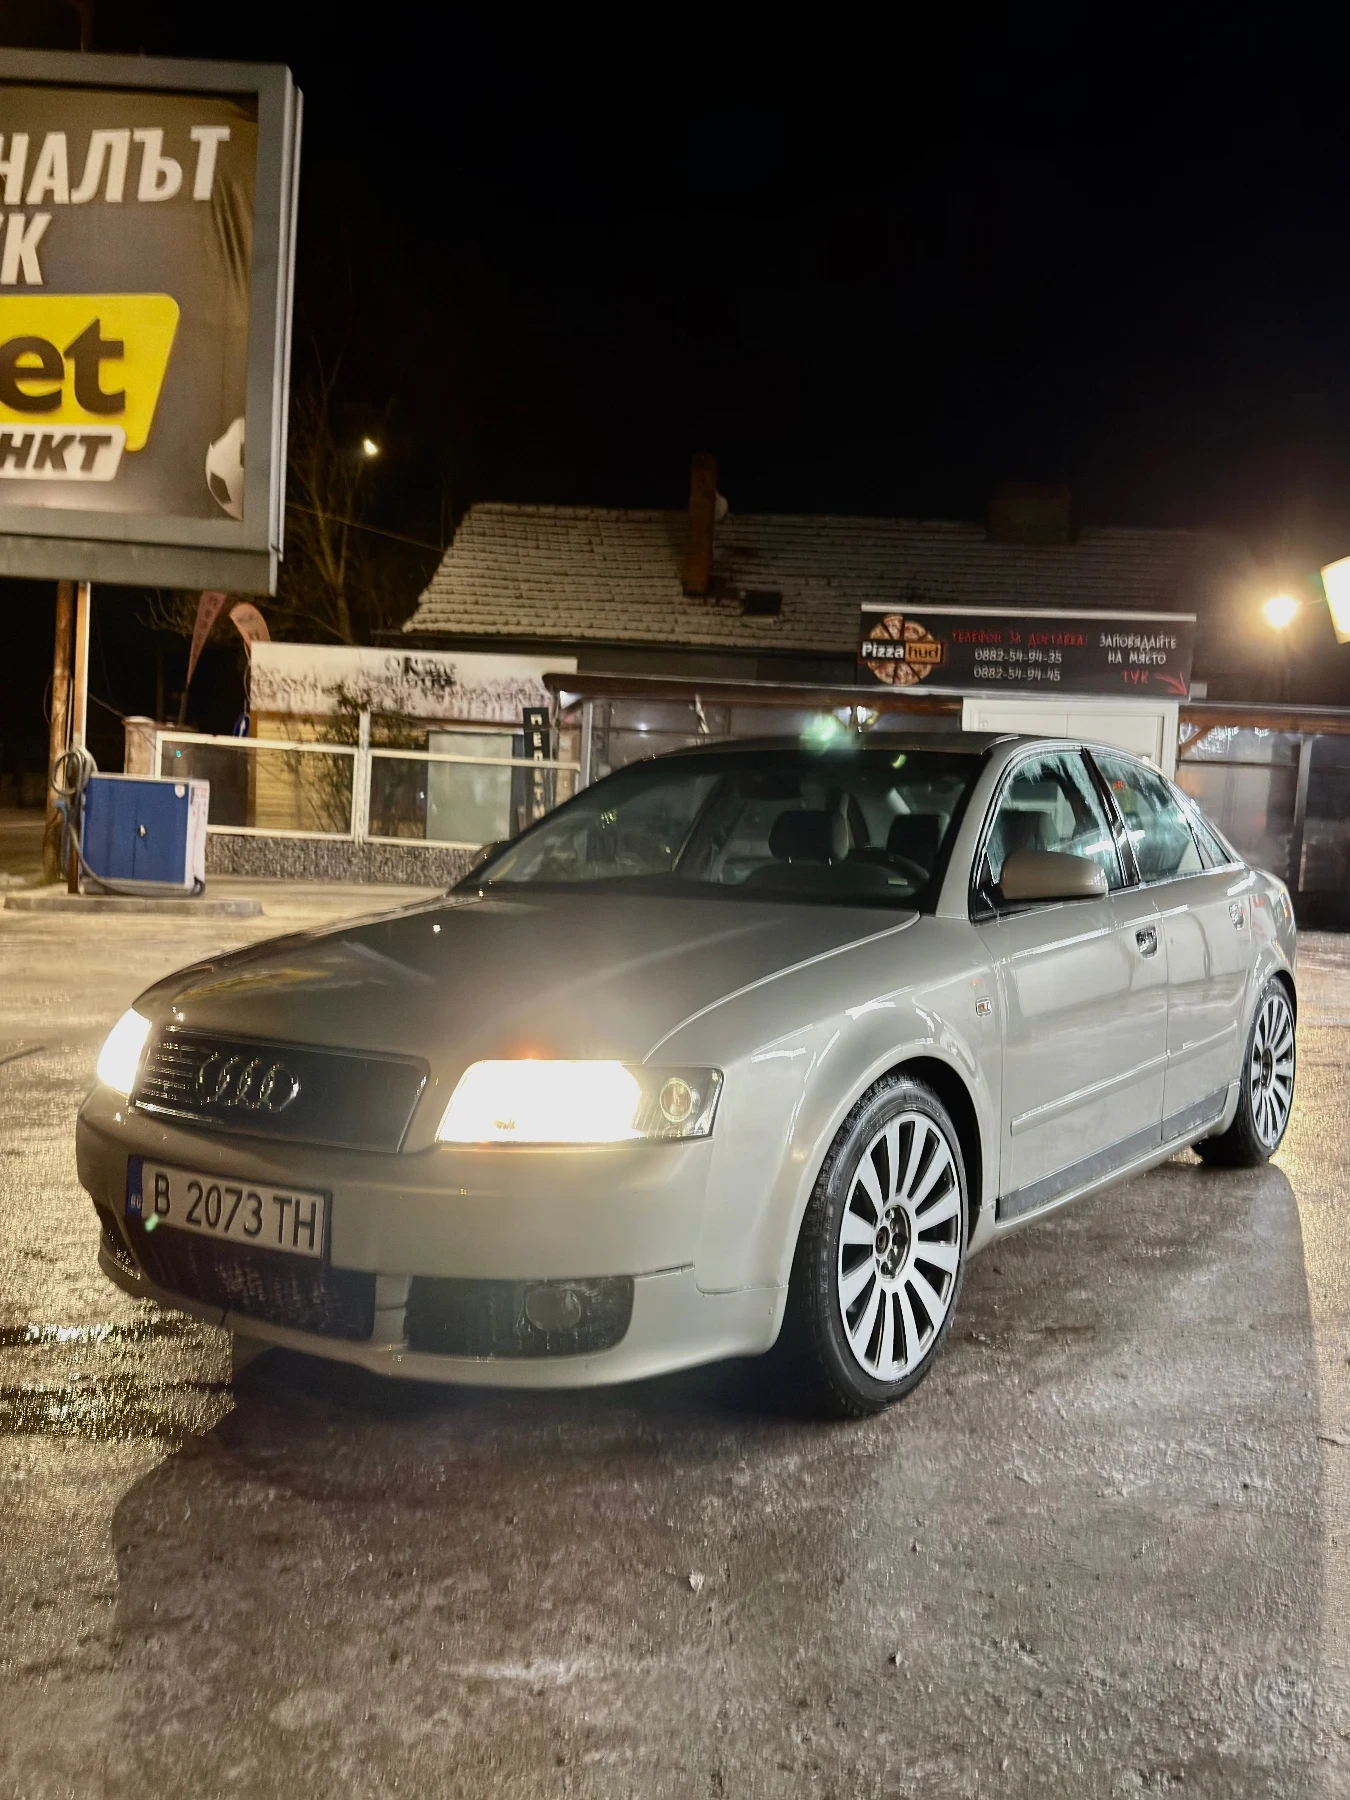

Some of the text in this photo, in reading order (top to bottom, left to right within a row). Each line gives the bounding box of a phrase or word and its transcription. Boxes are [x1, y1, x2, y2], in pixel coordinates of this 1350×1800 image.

[0, 213, 52, 286] К
[0, 315, 126, 416] et
[0, 433, 112, 474] НКТ
[861, 641, 939, 659] Pizza hud
[1099, 632, 1177, 652] ЗАПОВЯДАЙТЕ
[974, 647, 1063, 664] 0882-54-94-35
[1107, 650, 1167, 665] НА МЯСТО
[973, 665, 1061, 681] 0882-54-94-45
[1121, 669, 1149, 685] ТУК
[154, 1172, 317, 1250] B 2073 TH
